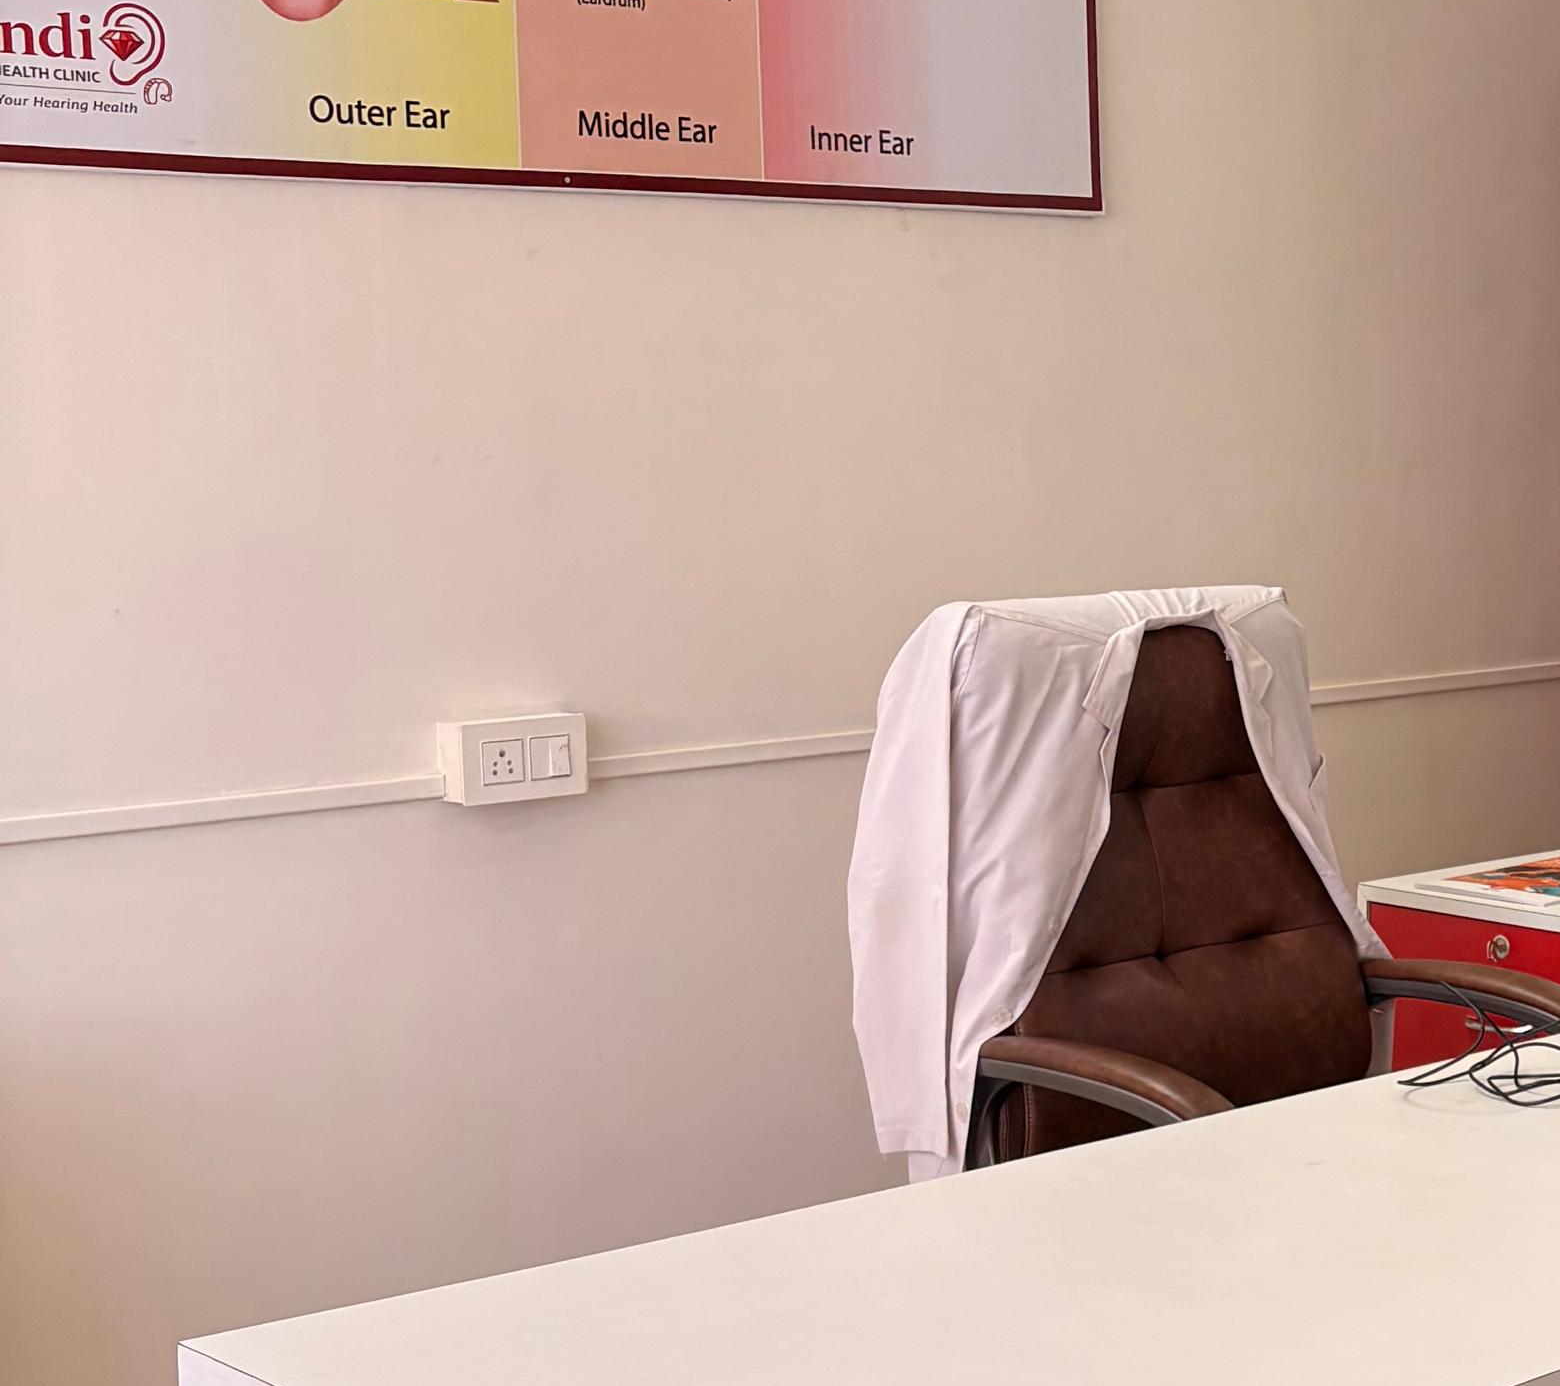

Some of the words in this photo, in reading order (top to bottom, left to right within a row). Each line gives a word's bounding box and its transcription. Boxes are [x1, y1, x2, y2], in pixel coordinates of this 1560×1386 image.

[0, 64, 49, 80] EALTH
[53, 68, 101, 83] CLINIC
[33, 96, 88, 113] Hearing
[93, 101, 138, 113] Health
[308, 94, 396, 128] Outer
[404, 99, 450, 130] Ear
[578, 110, 670, 142] Middle
[677, 117, 717, 144] Ear
[810, 125, 872, 153] Inner
[879, 130, 914, 157] Ear
